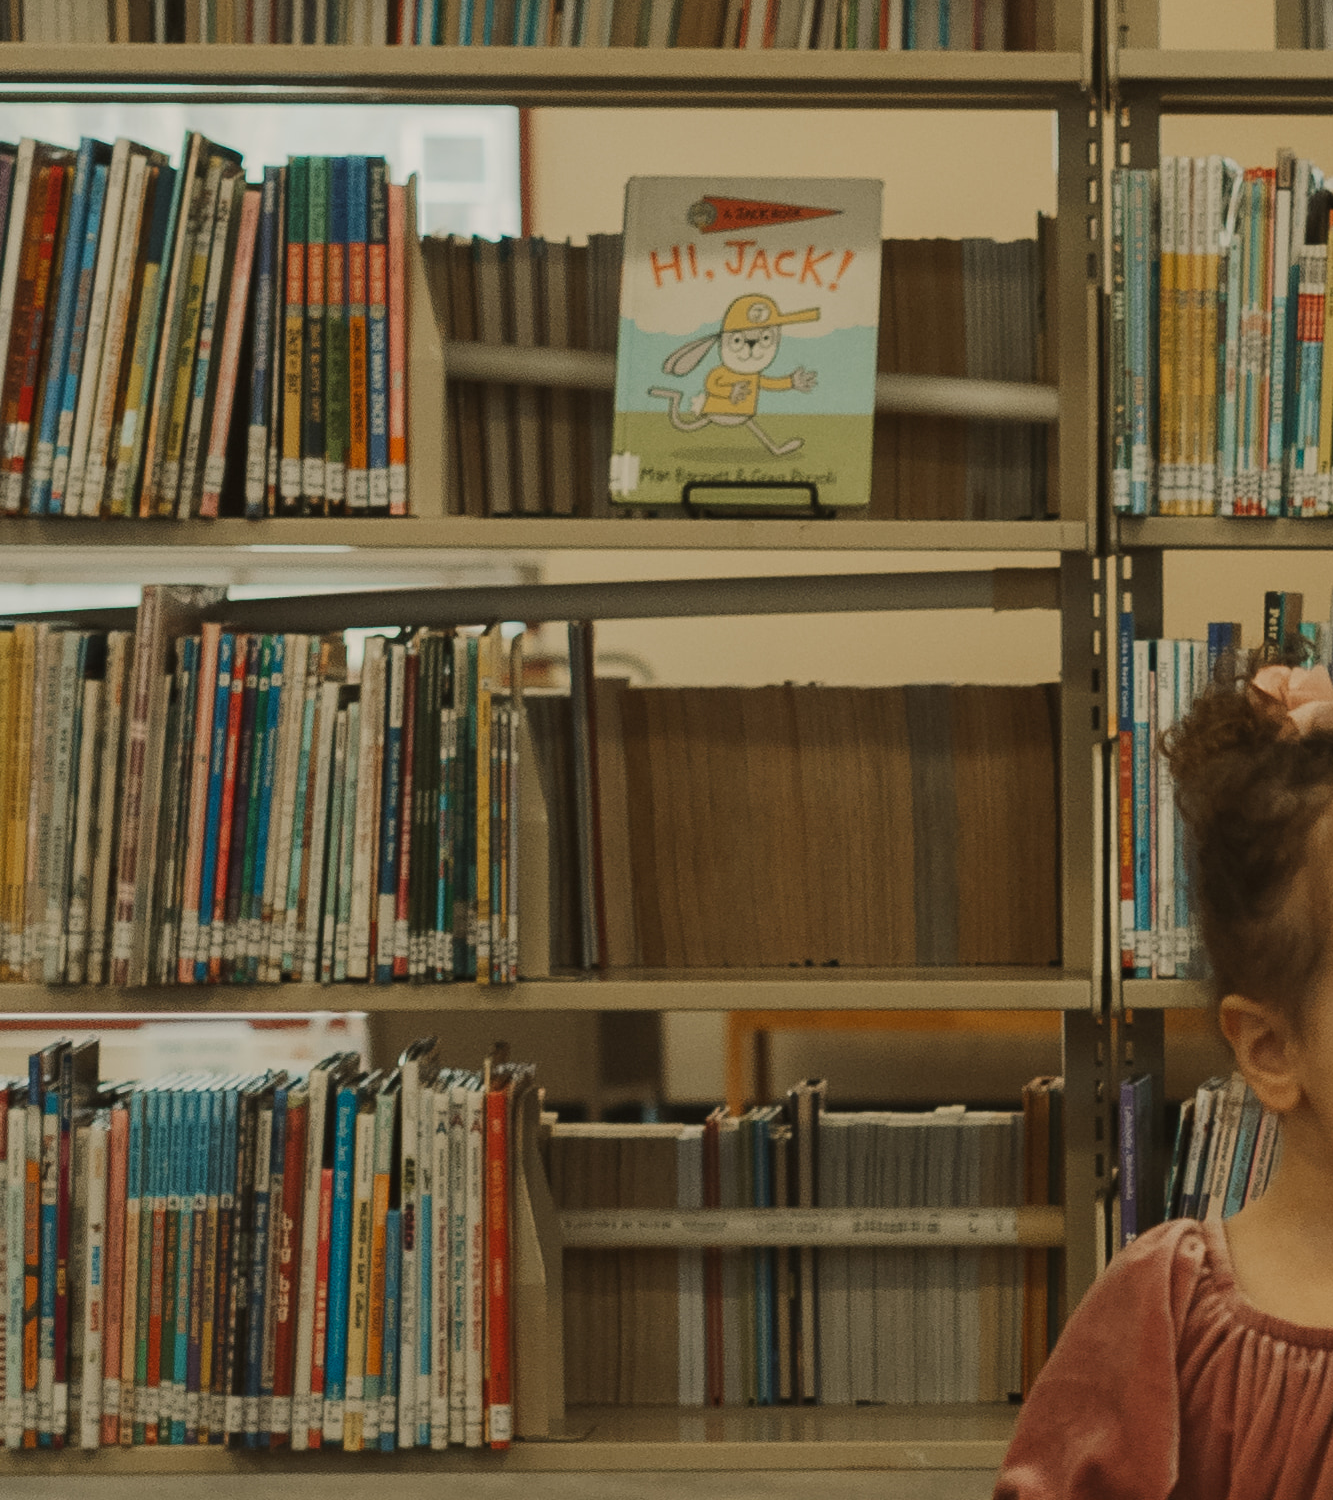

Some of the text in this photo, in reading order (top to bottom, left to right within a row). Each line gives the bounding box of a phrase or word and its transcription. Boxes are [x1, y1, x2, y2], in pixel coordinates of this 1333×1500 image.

[725, 240, 856, 292] JACK!
[372, 321, 384, 345] TOO
[371, 353, 384, 390] MANY
